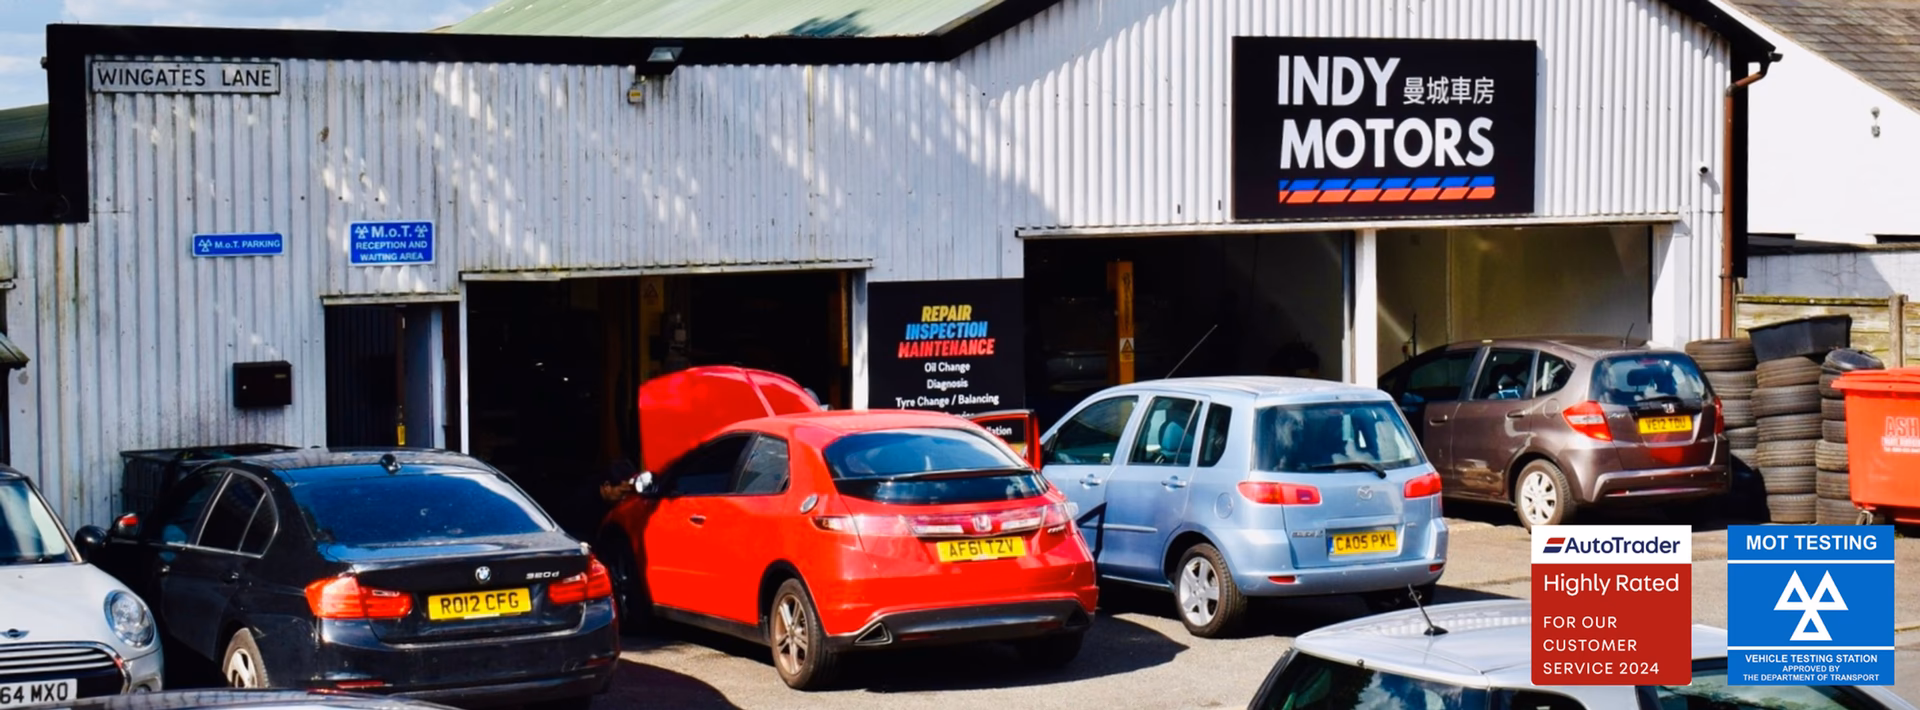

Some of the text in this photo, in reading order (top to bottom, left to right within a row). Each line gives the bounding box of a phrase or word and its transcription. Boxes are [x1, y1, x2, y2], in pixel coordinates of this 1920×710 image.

[97, 68, 272, 86] WINGATES LANE
[1278, 55, 1401, 106] INDY
[1403, 76, 1495, 105] 曼城車房
[1280, 117, 1495, 169] MOTORS
[371, 225, 412, 238] M.o.T.
[242, 239, 281, 248] PARKING
[355, 240, 428, 250] RECEPTION AND
[360, 252, 424, 262] WAITING AREA
[921, 304, 973, 322] REPAIR
[905, 321, 988, 340] INSPECTION
[898, 338, 995, 358] MAINTENANCE
[924, 362, 971, 374] Oil Change
[926, 378, 969, 391] Diagnosis
[895, 397, 916, 410] Tyre
[917, 395, 950, 408] Change
[958, 392, 999, 405] Balancing
[949, 538, 1014, 557] AF61 TZV
[1336, 533, 1395, 551] CA05 PXL
[485, 592, 519, 611] CFG
[30, 682, 68, 702] MXO
